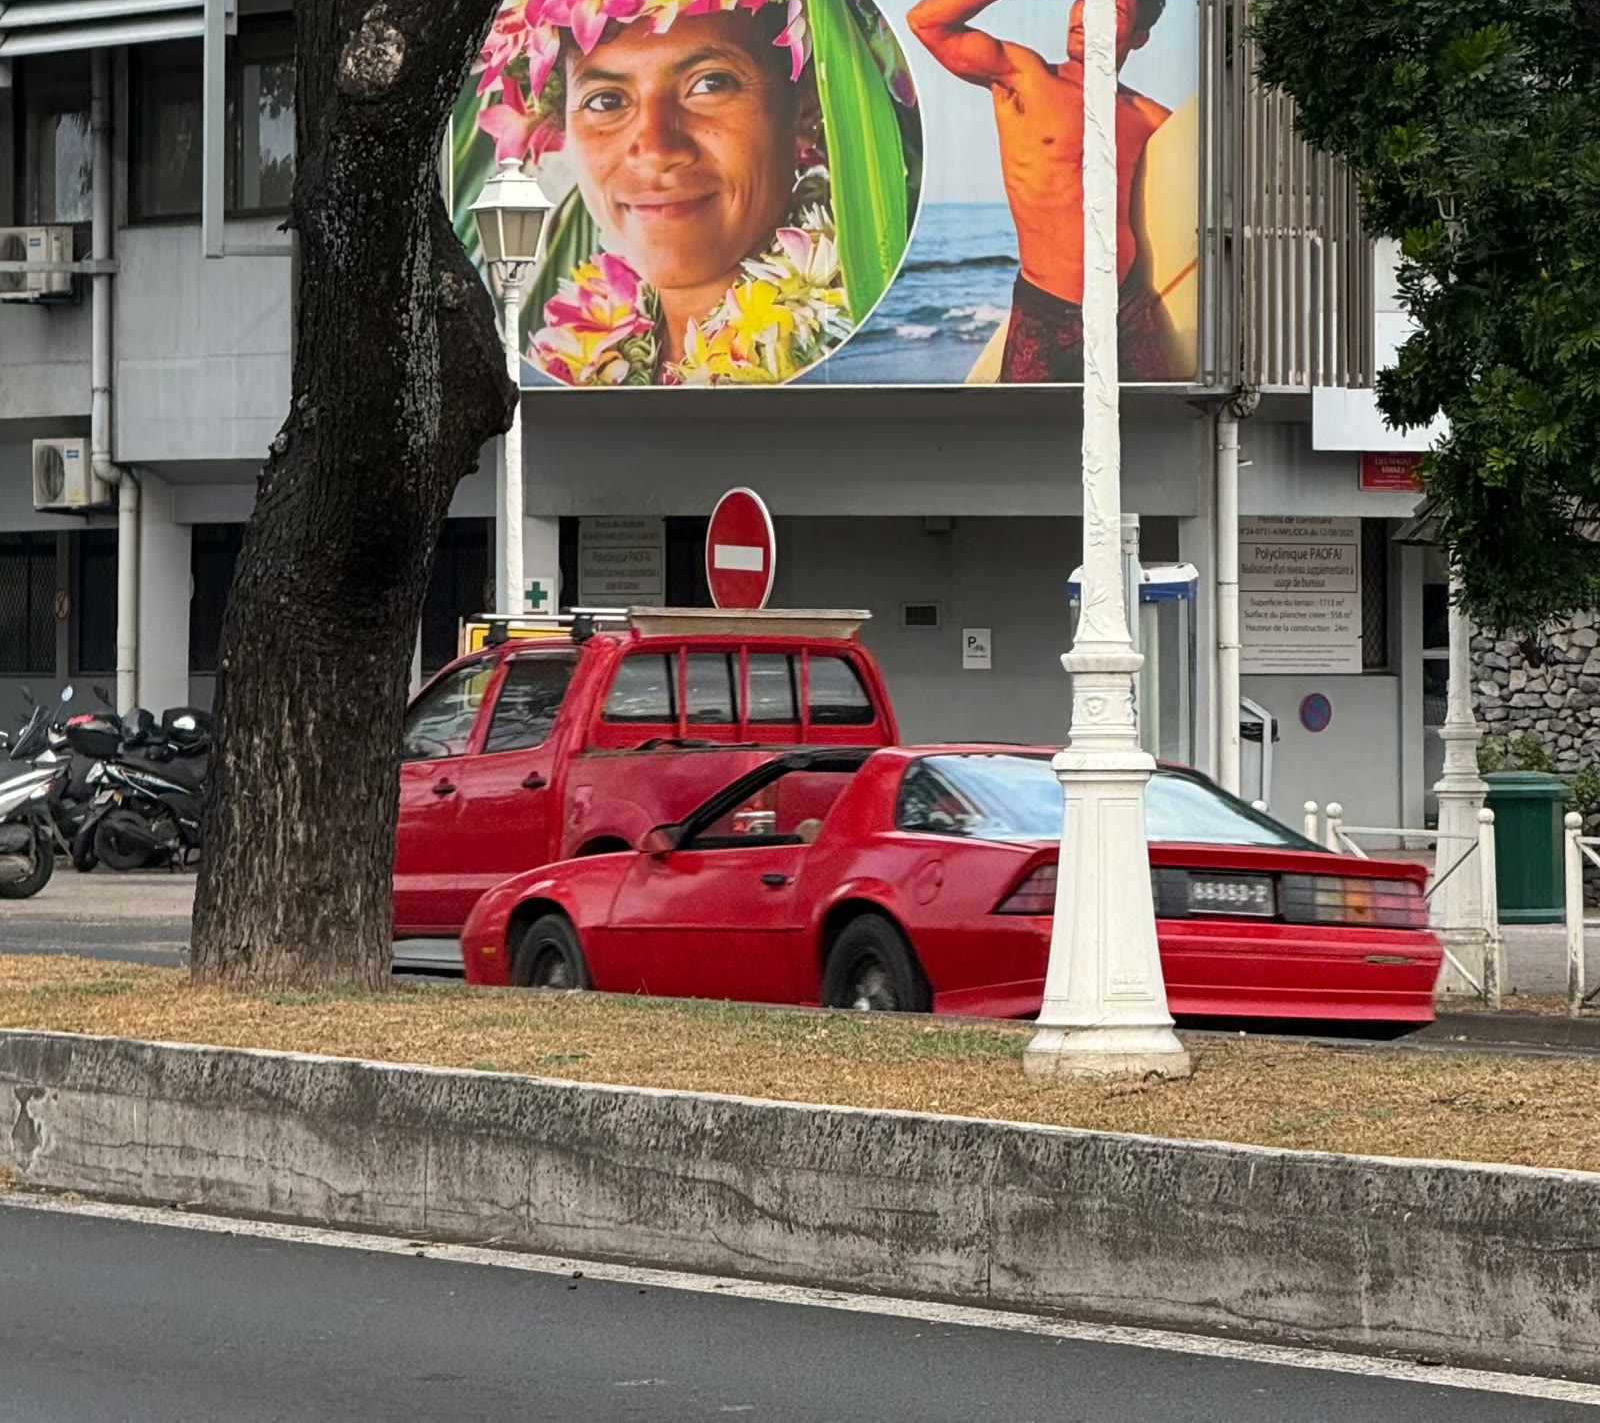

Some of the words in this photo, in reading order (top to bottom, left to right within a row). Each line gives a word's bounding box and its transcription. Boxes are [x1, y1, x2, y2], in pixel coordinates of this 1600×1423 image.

[1255, 546, 1308, 562] Polyclinique
[1309, 547, 1342, 561] PAOFAI
[1244, 609, 1268, 619] Surface
[1245, 624, 1272, 632] Hauteur
[1273, 624, 1282, 632] de
[1283, 624, 1289, 632] la
[1290, 624, 1330, 632] construction
[968, 636, 977, 648] P
